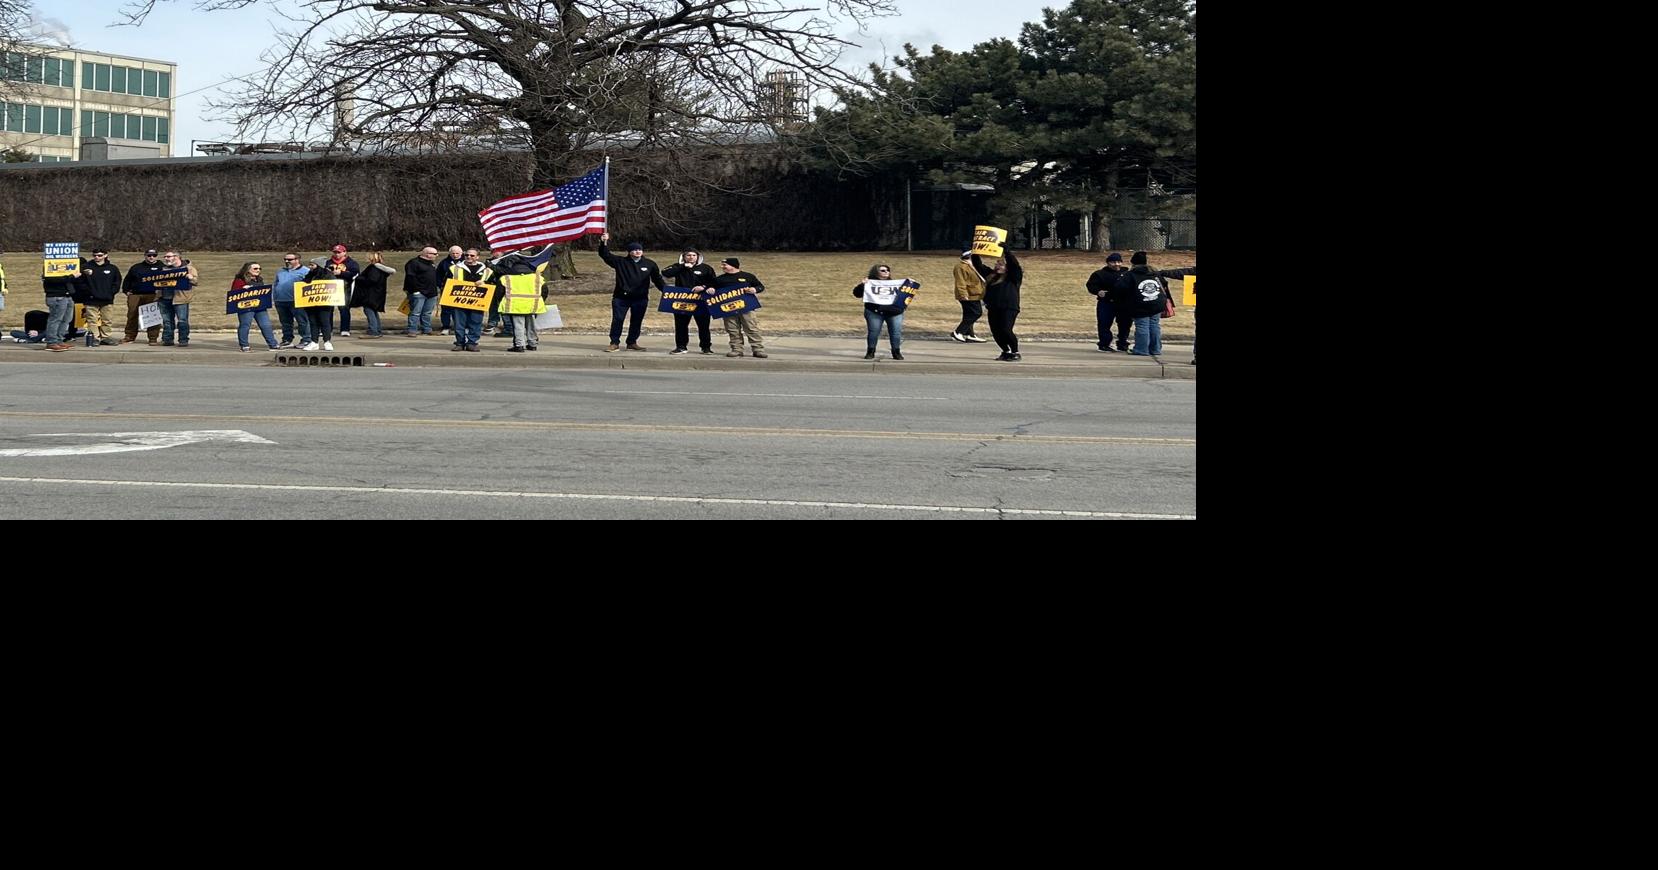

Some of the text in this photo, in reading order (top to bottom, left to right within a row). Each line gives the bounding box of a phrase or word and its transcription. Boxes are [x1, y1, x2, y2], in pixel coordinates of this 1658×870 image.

[45, 247, 79, 255] UNION
[142, 271, 188, 282] SOLIDARITY
[228, 288, 271, 303] SOLIDARITY
[303, 288, 336, 296] CONTRACT
[308, 295, 332, 303] NOW!
[706, 287, 749, 306] SOLIDARIT
[453, 297, 479, 305] NOW!
